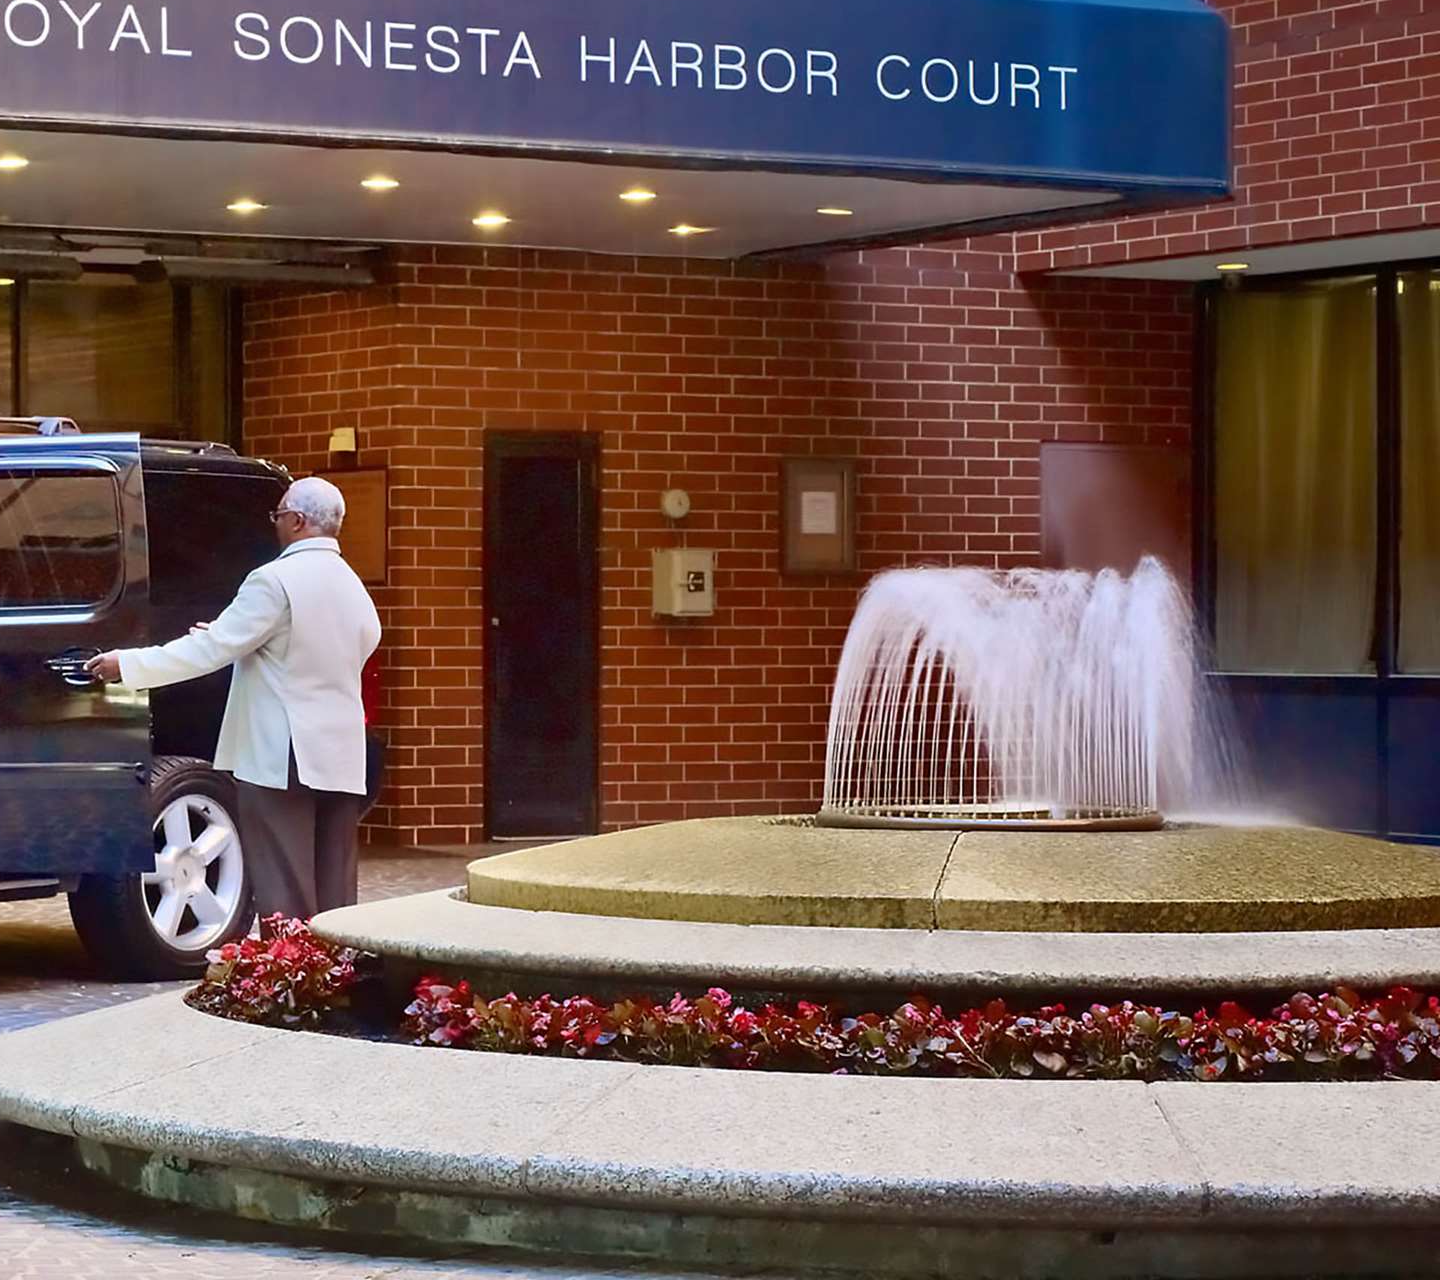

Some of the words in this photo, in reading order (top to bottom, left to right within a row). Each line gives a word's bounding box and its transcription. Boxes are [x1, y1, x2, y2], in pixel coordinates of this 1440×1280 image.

[233, 11, 542, 80] SONESTA
[580, 34, 838, 97] HARBOR
[876, 54, 1079, 111] COURT
